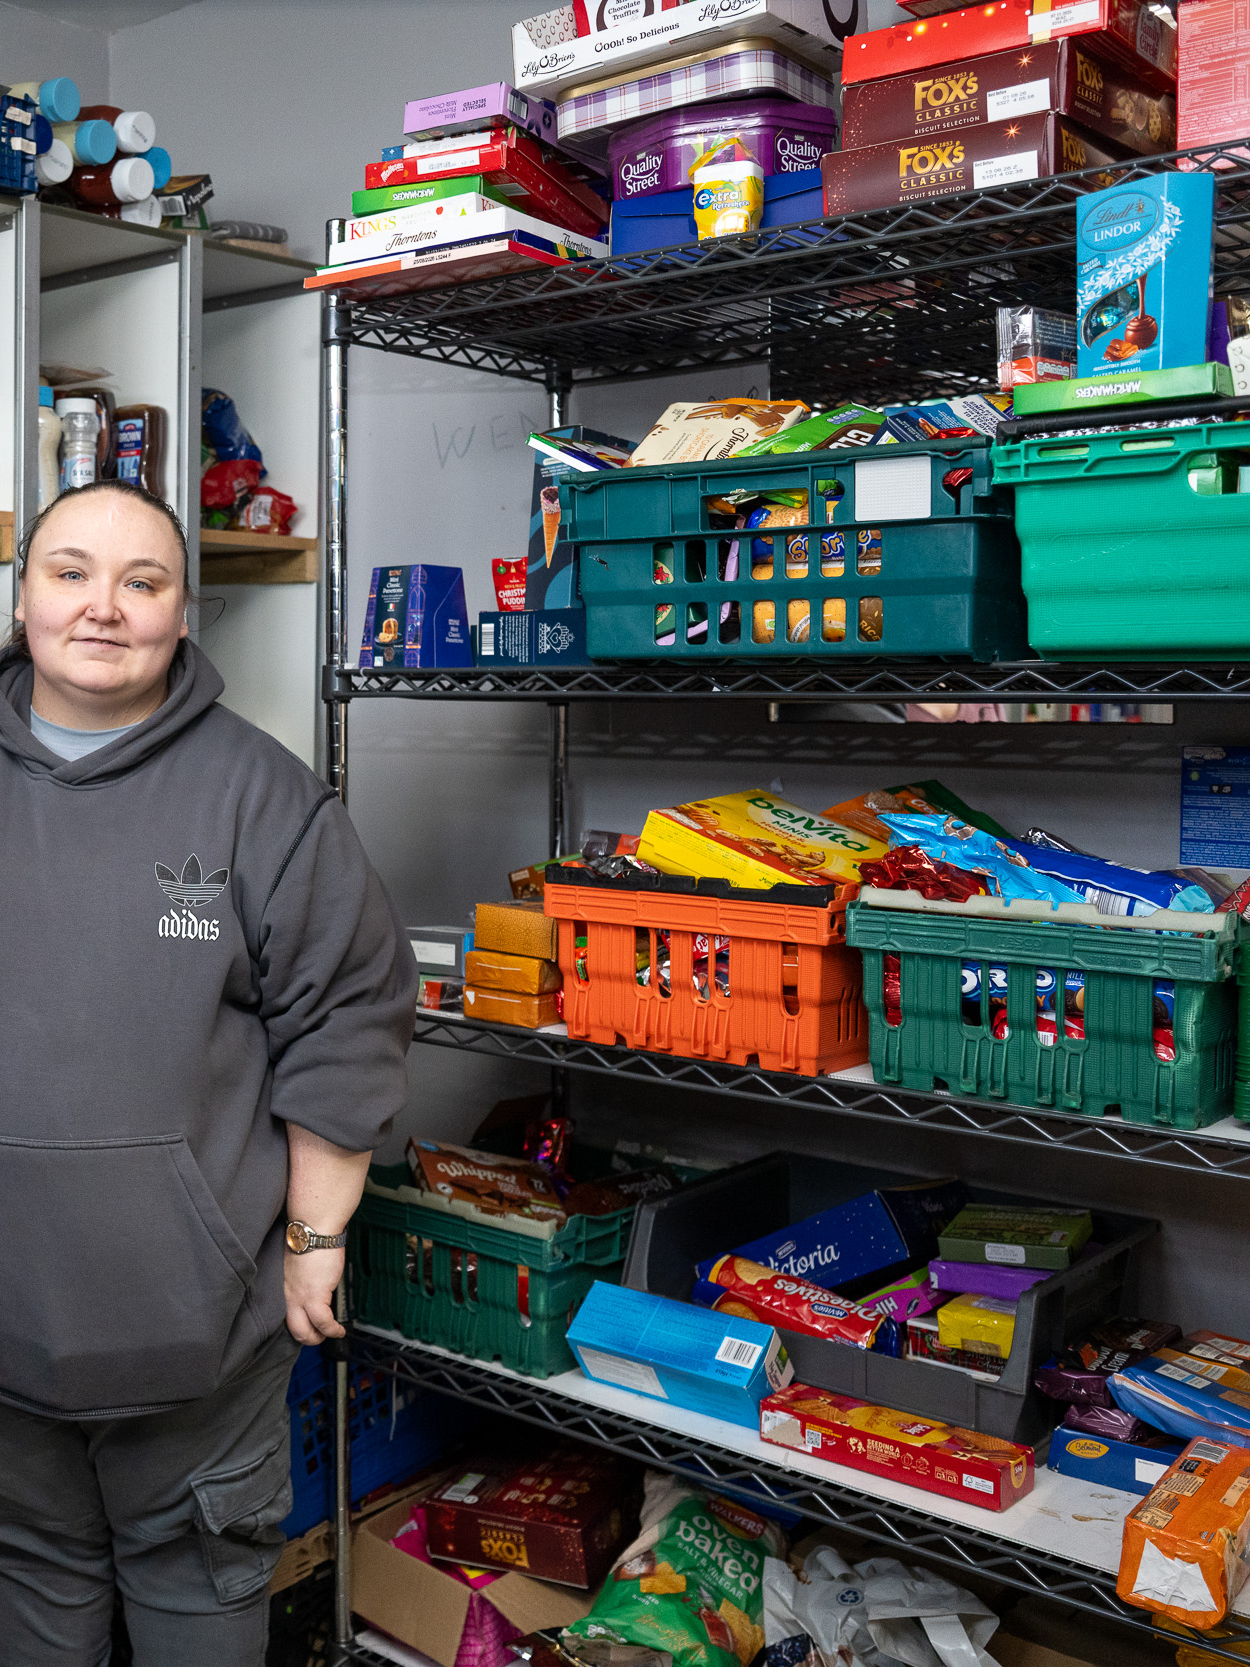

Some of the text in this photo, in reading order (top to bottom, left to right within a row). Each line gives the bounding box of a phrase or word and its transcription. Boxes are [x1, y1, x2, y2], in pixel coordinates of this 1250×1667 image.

[607, 1, 641, 15] Chocolate
[612, 8, 639, 21] Truffles
[698, 4, 721, 21] Lily
[626, 34, 638, 44] So
[640, 22, 680, 40] Delicious
[521, 52, 576, 77] Lily O'Brien's
[1076, 51, 1104, 92] FOX'S
[934, 71, 967, 83] SINCE 1853
[462, 97, 487, 107] SELECTED
[914, 72, 979, 111] FOX'S
[1076, 86, 1103, 104] CLASSIC
[461, 103, 487, 112] SPECIALLY
[915, 100, 978, 122] CLASSIC
[914, 115, 980, 135] BISCUIT SELECTION
[776, 137, 822, 163] Quality
[920, 140, 953, 152] SINCE 1853
[1061, 126, 1087, 166] FOX'S
[620, 153, 663, 181] Quality
[781, 157, 817, 172] Street
[899, 141, 965, 177] FOX'S
[625, 173, 660, 196] Street
[900, 169, 964, 189] CLASSIC
[392, 186, 435, 201] MATCHMAKERS
[698, 189, 740, 207] extra
[899, 184, 966, 202] BISCUIT SELECTION
[711, 199, 750, 212] Refreshers
[1093, 204, 1134, 227] Lindt
[349, 215, 397, 241] KINGS
[1093, 220, 1142, 242] LINDOR
[385, 230, 438, 252] Thorntons
[560, 232, 592, 257] Thorntons
[1080, 261, 1102, 275] CARAMEL
[1081, 257, 1098, 269] SALTED
[1093, 358, 1141, 372] IRRESISTIBLY SMOOTH
[1114, 366, 1143, 376] CARAMEL
[1075, 380, 1142, 399] MATCHMAKERS
[498, 587, 526, 598] CHRISTM
[859, 619, 881, 641] RICE
[746, 796, 871, 852] belVita
[771, 820, 813, 839] MINIS
[158, 908, 220, 941] adidas
[1000, 935, 1042, 949] TESCO
[437, 1161, 517, 1185] Whipped
[772, 1242, 841, 1279] ictoria
[773, 1277, 884, 1323] Digestives
[866, 1438, 893, 1452] SEEDING
[710, 1502, 764, 1535] WALKERS
[480, 1526, 526, 1543] CLASSIC
[692, 1515, 760, 1570] oven
[480, 1537, 530, 1569] FOX'S
[675, 1520, 760, 1596] baked
[677, 1542, 744, 1600] SALT & VINEGAR
